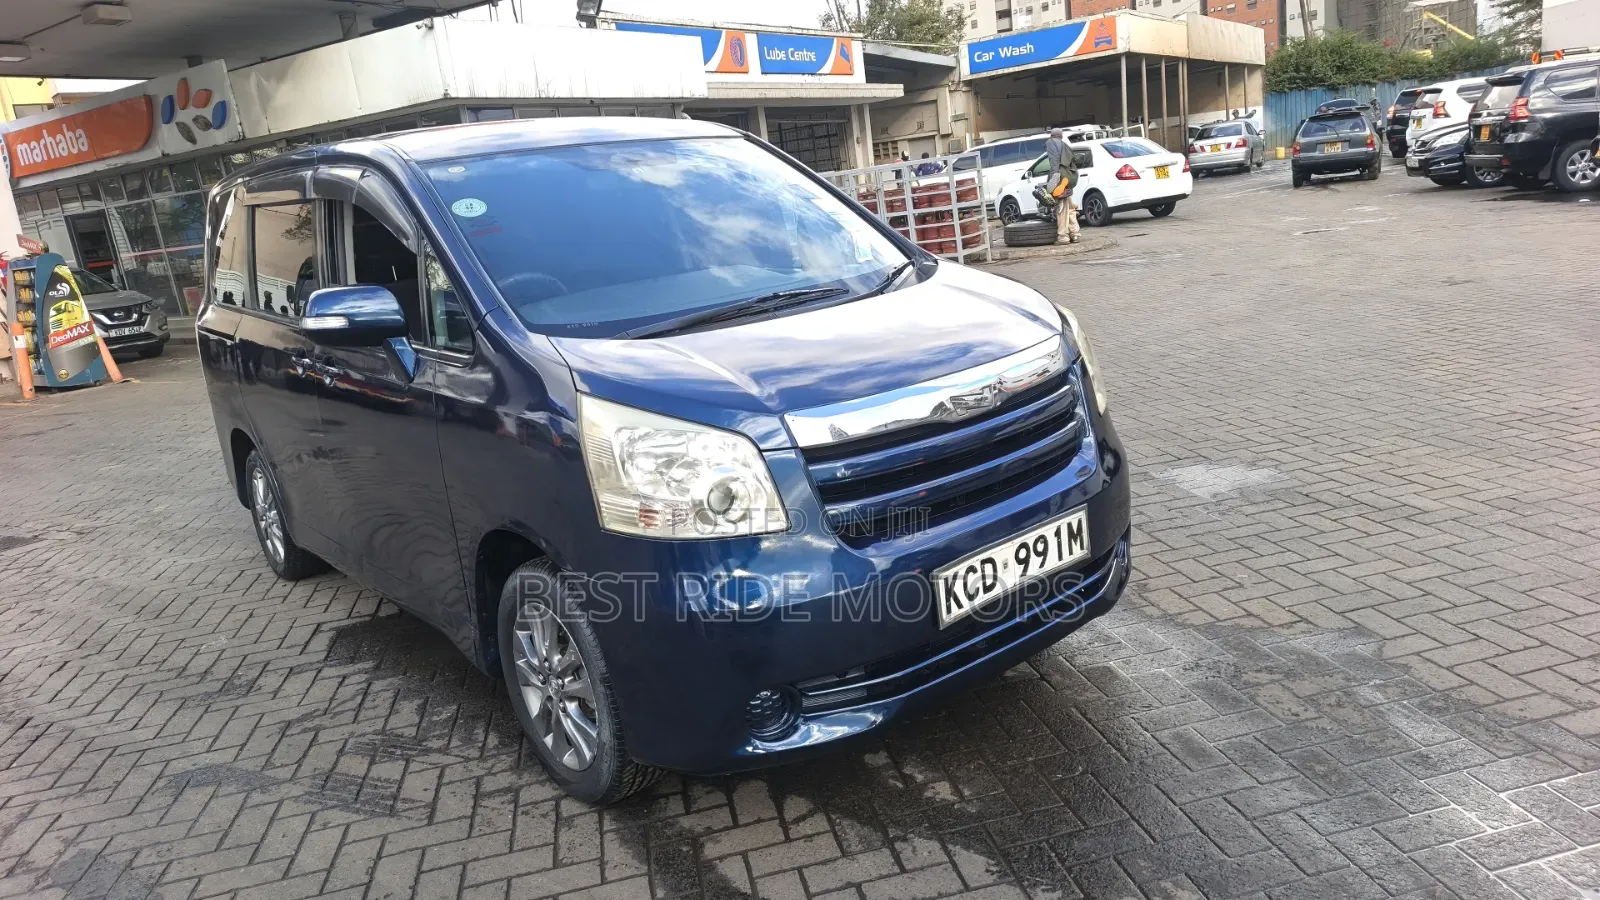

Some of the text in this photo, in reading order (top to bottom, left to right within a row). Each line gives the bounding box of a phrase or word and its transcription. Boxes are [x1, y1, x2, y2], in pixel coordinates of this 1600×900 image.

[763, 46, 817, 62] Lube Centre
[974, 42, 1035, 63] Car Wash
[16, 123, 89, 166] marhaba
[51, 323, 90, 344] DeoMAX
[943, 517, 1085, 616] KCD 991M
